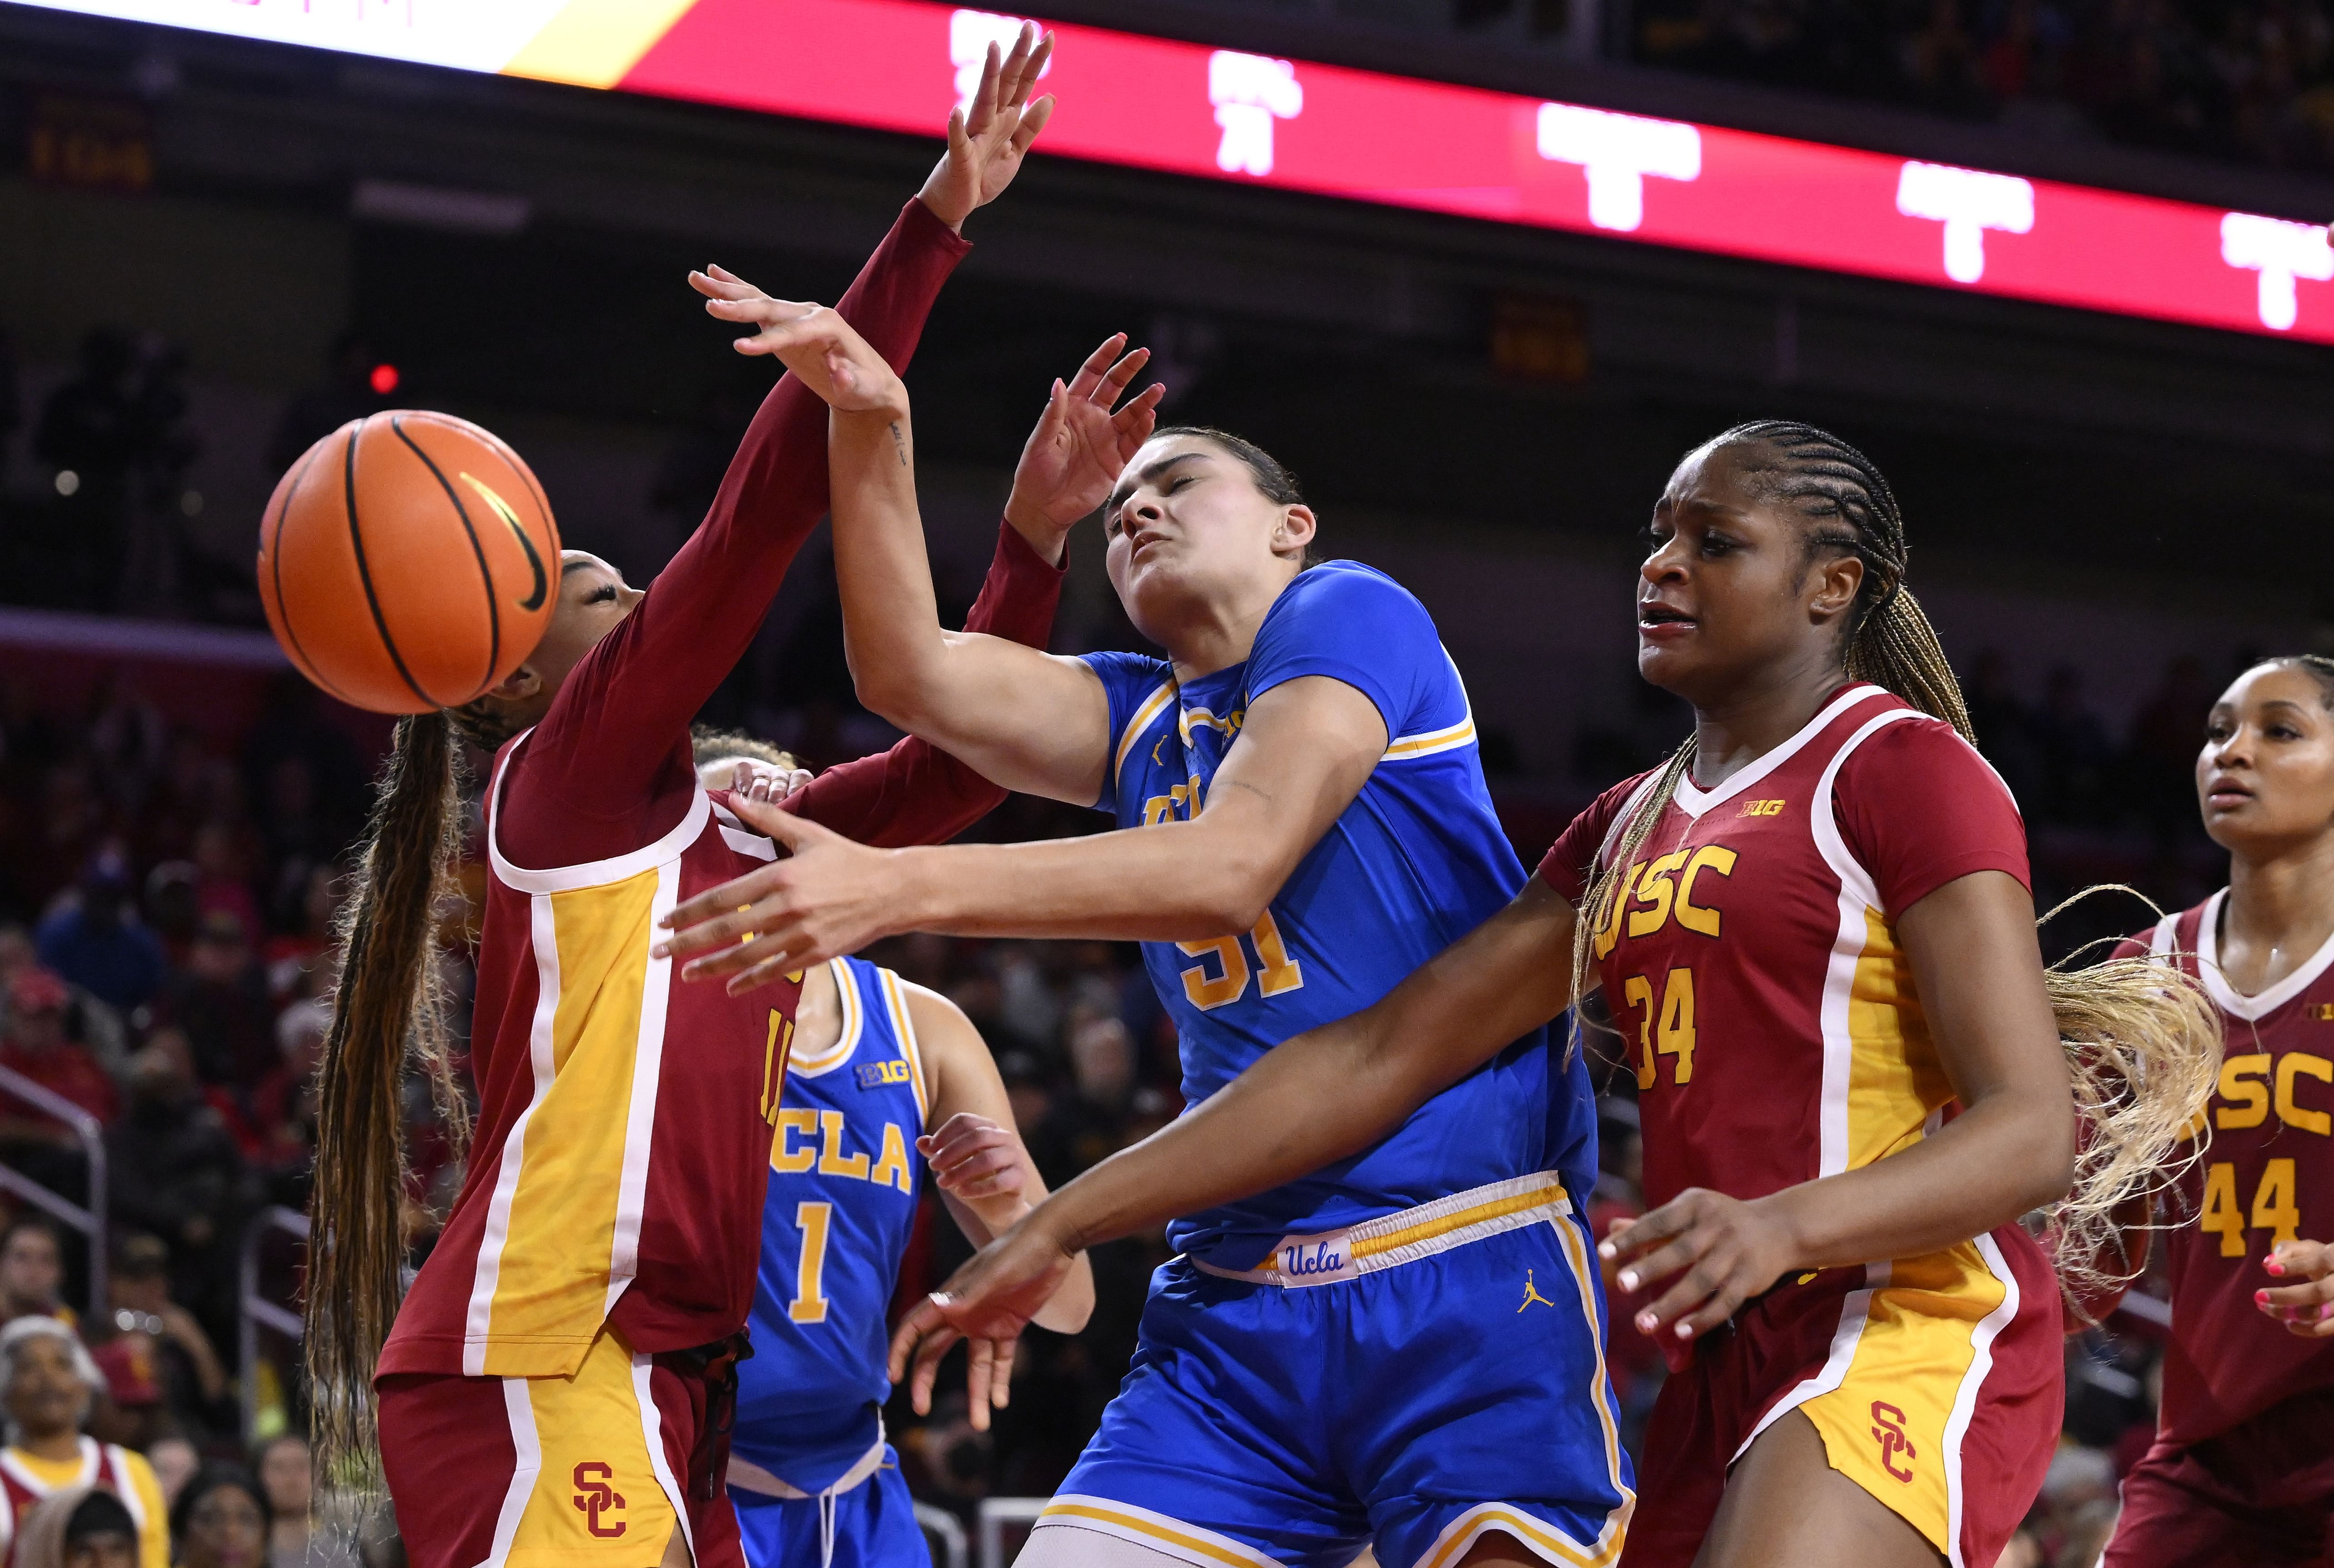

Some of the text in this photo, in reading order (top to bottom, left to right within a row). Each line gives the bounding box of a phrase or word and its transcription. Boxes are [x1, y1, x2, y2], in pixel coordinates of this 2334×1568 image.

[1594, 843, 1739, 960] USC
[1625, 968, 1696, 1090] 34
[2176, 1052, 2333, 1142] SC
[770, 1108, 911, 1196] CLA
[2201, 1158, 2299, 1256] 44
[789, 1201, 831, 1324] 1
[1285, 1241, 1344, 1275] Ucla
